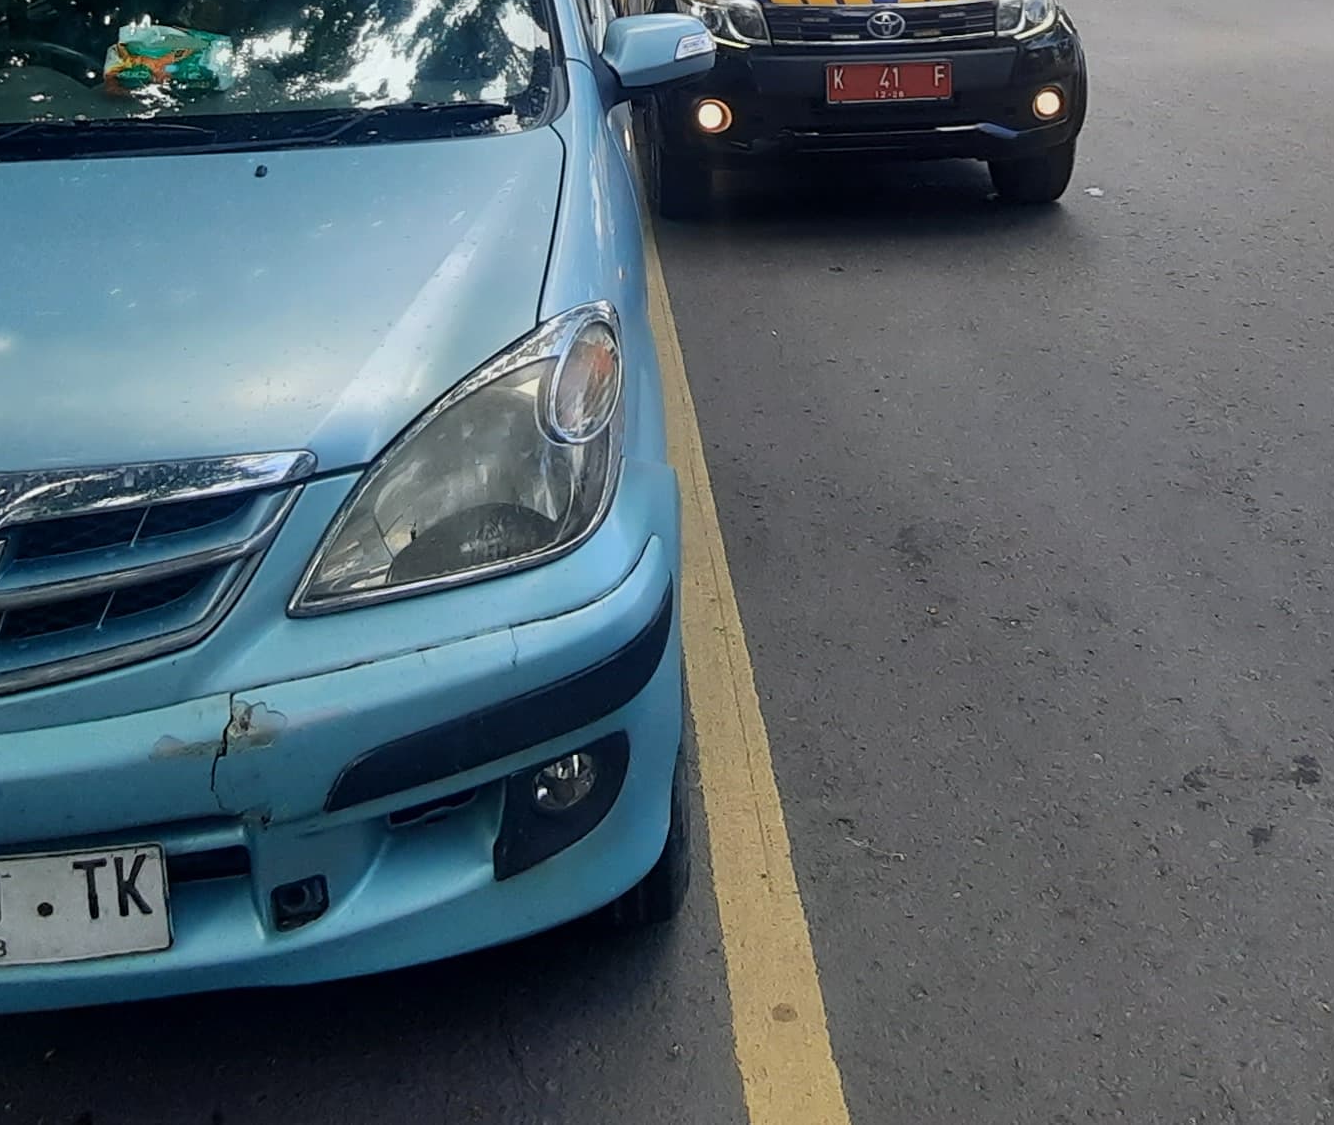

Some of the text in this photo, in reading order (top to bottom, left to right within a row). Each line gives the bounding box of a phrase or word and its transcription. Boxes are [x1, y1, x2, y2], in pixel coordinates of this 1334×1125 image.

[834, 65, 945, 90] K 41 F
[73, 853, 154, 921] TK
